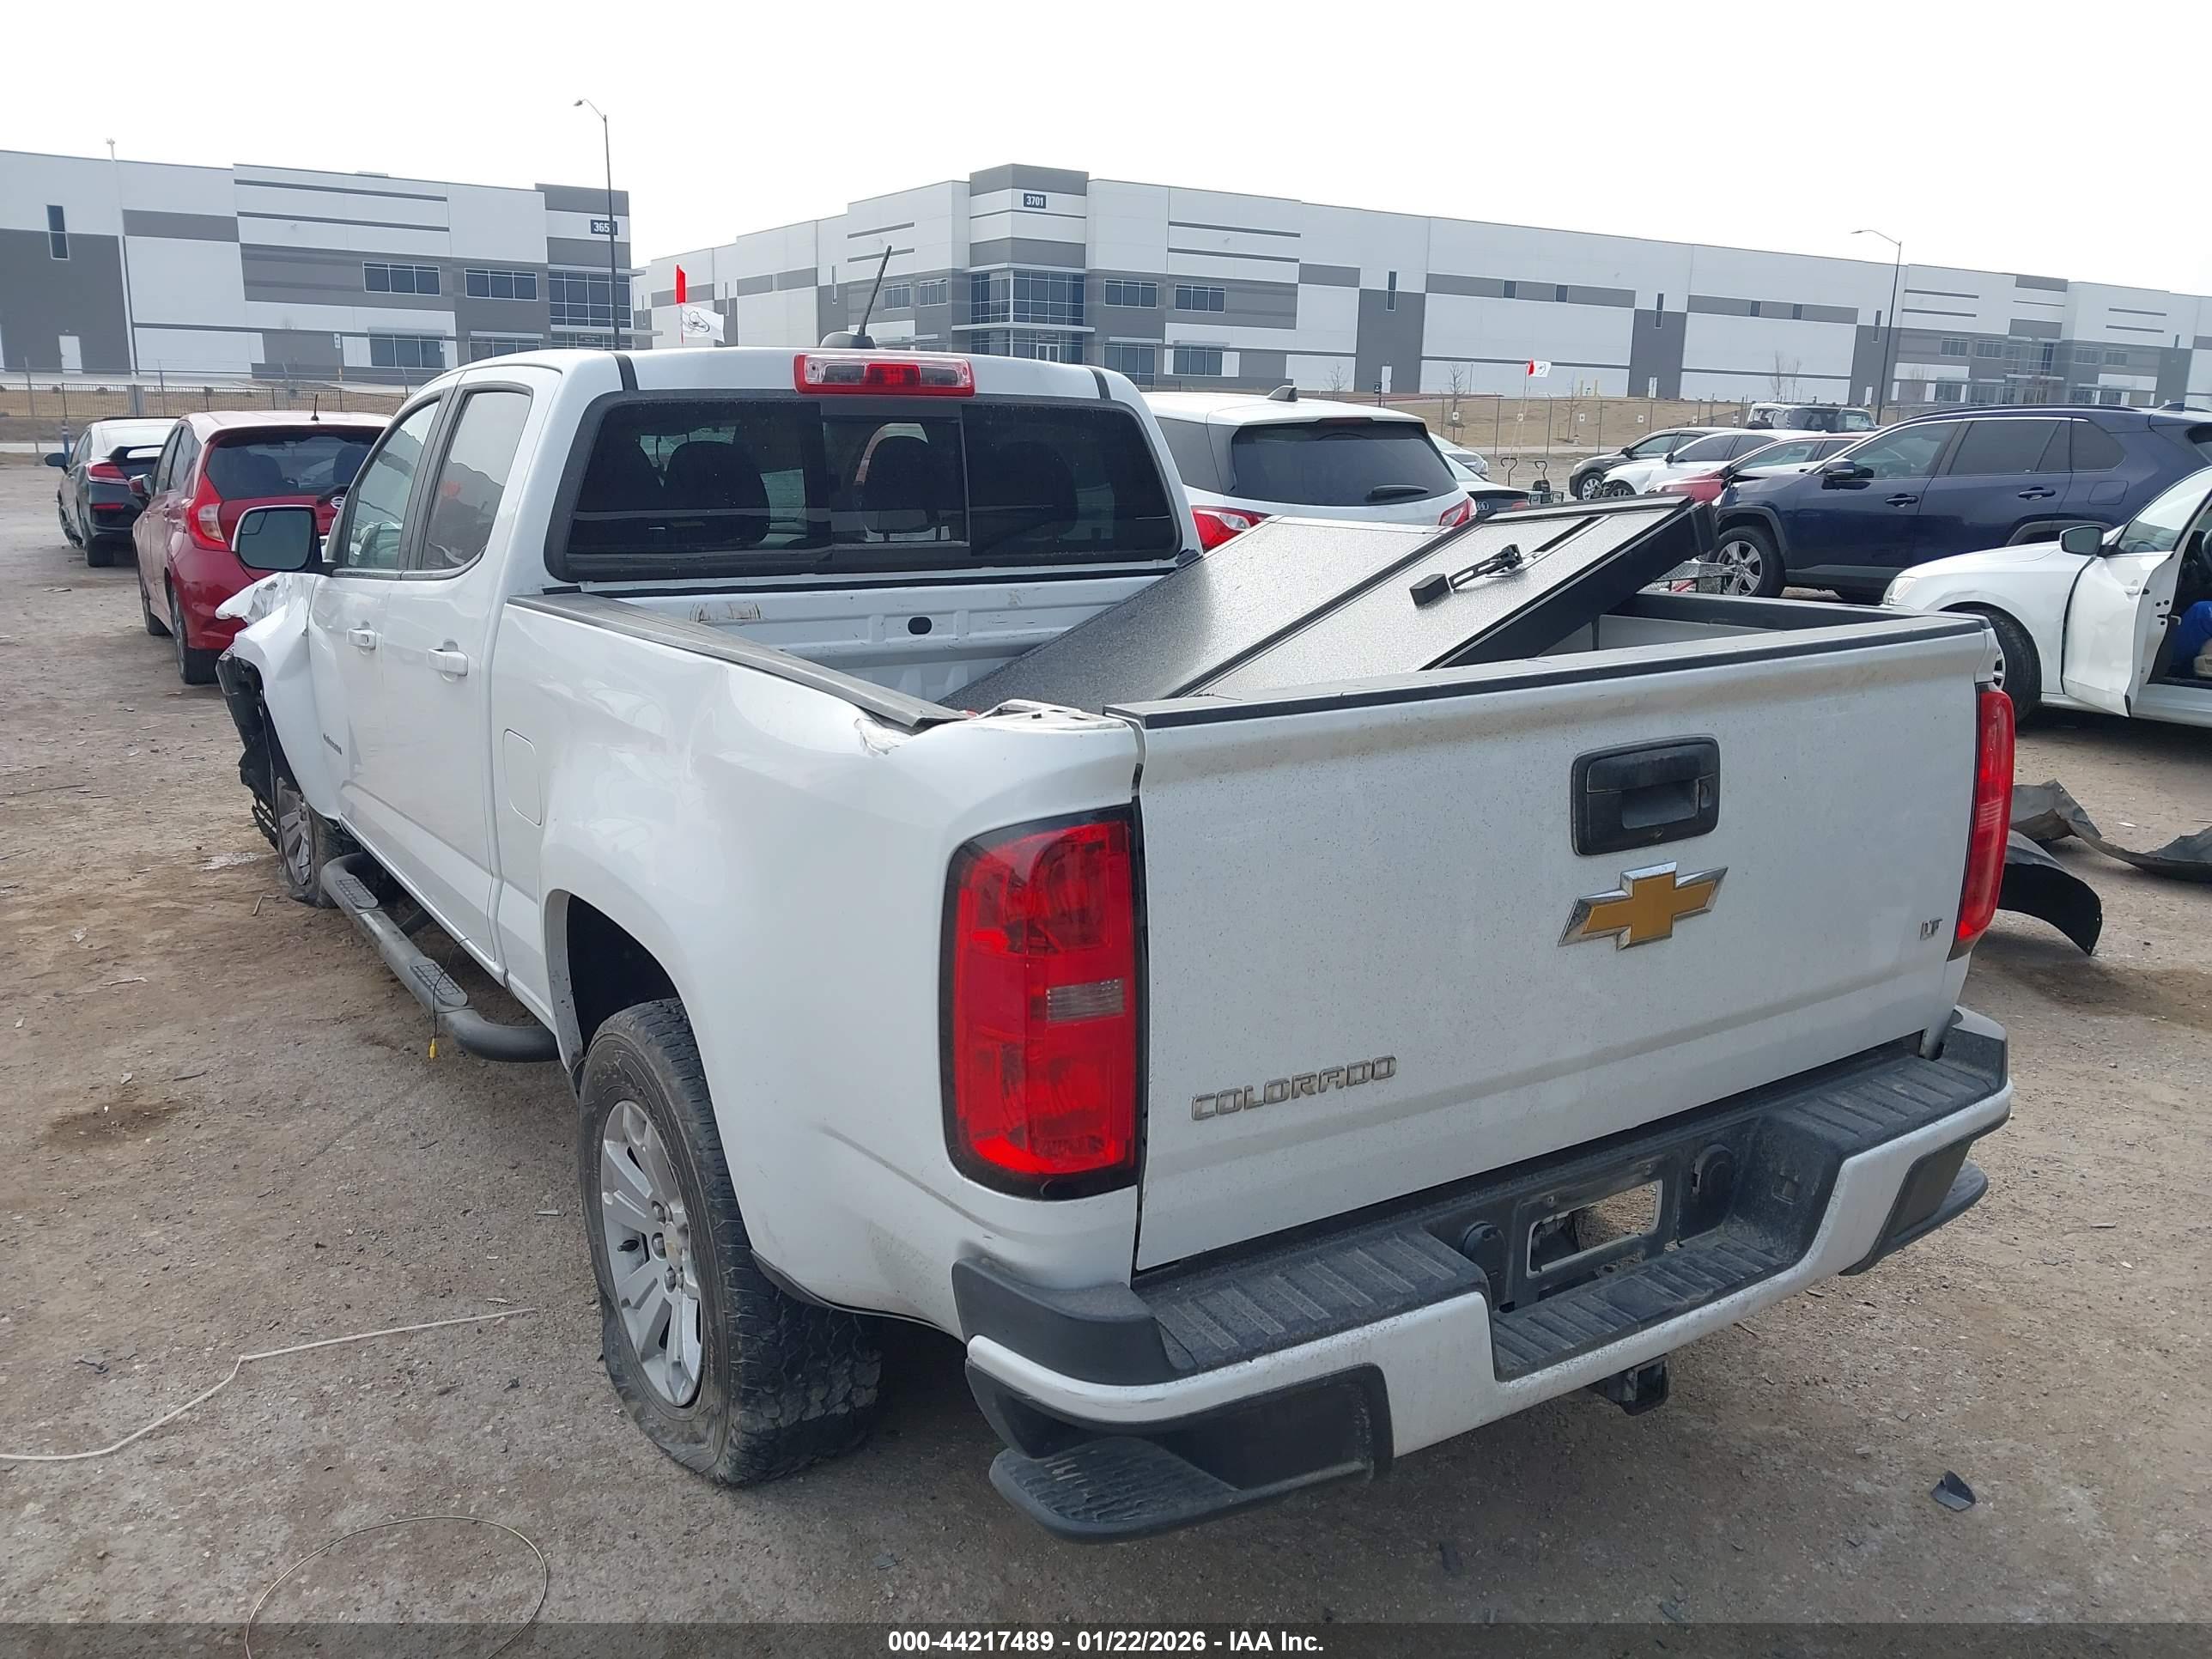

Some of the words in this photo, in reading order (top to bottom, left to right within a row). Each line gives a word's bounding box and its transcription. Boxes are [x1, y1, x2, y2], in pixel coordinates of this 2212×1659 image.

[1026, 195, 1044, 207] 3701
[1919, 918, 1943, 941] LT
[1190, 1054, 1398, 1121] COLORADO
